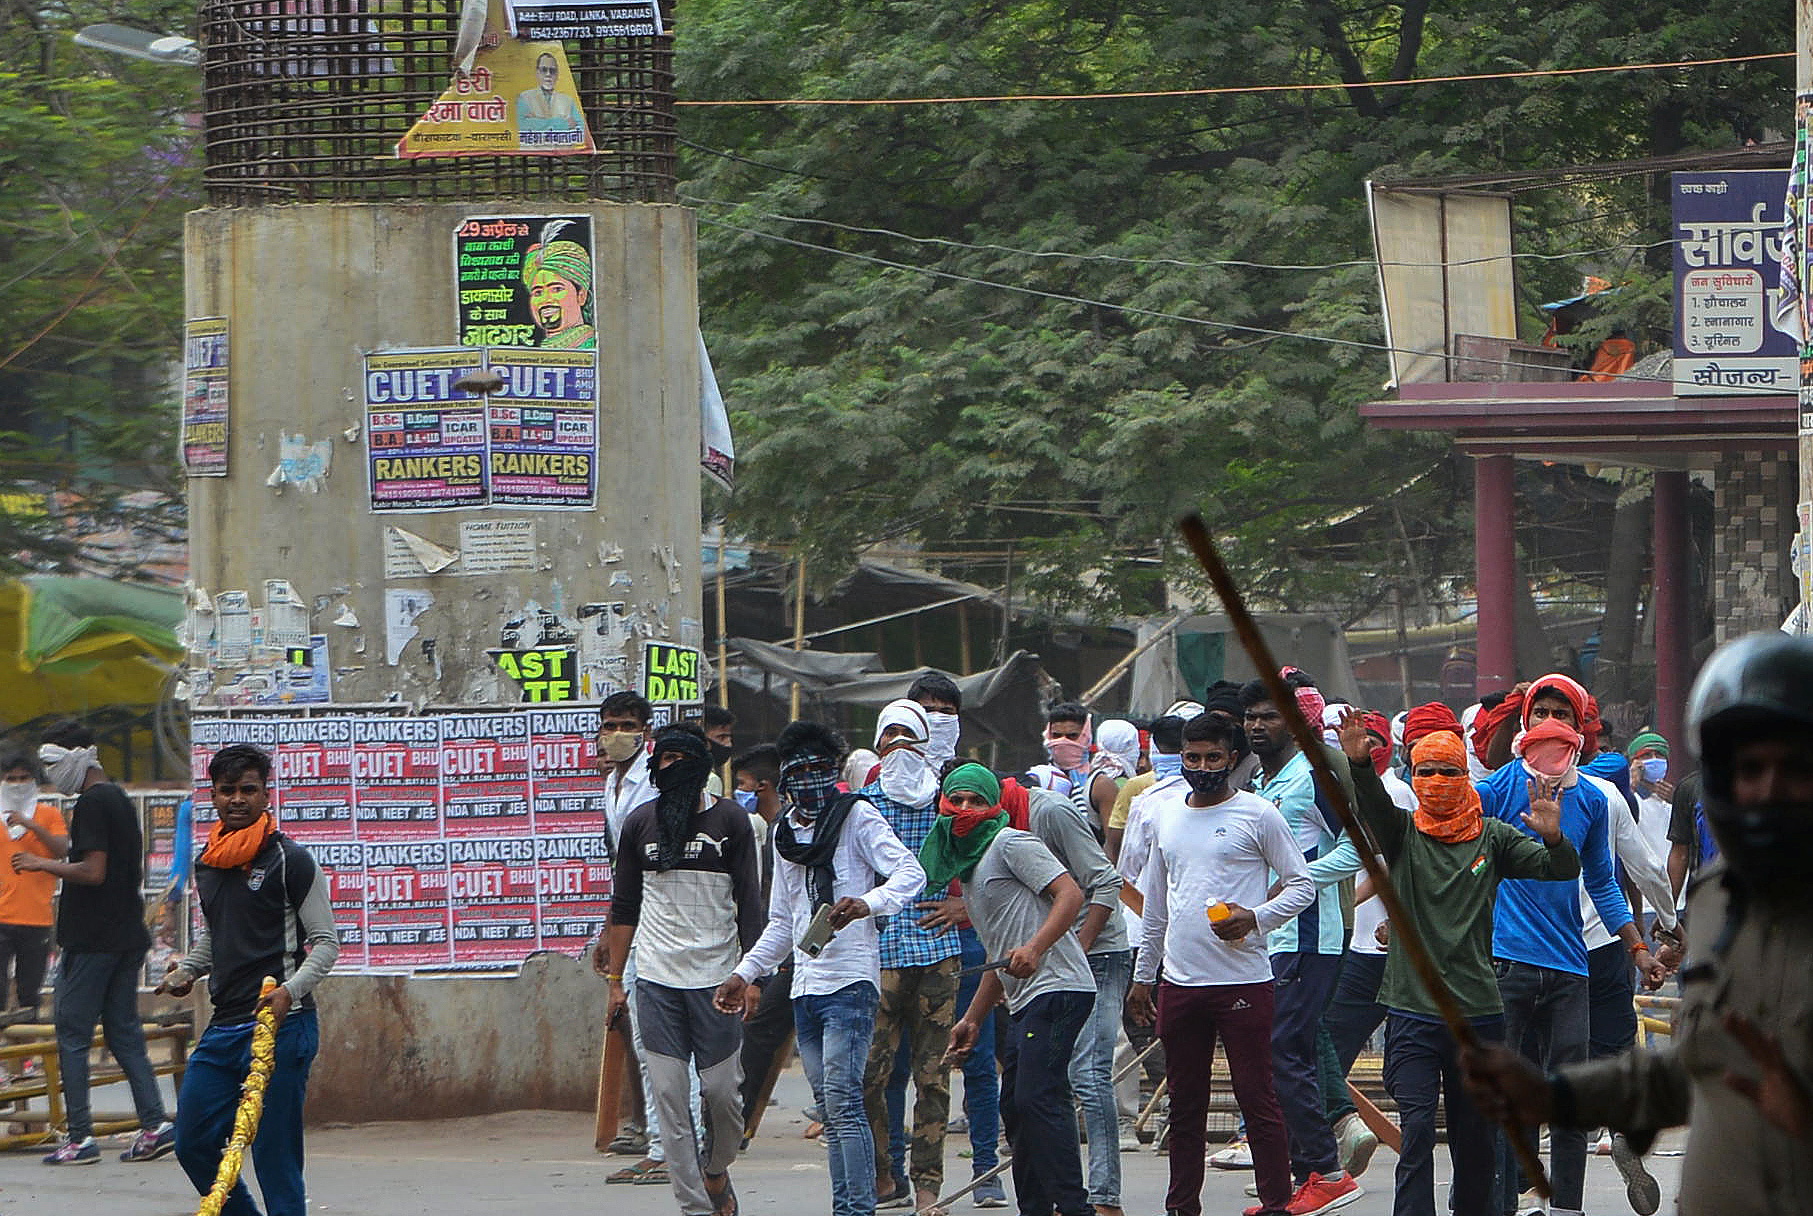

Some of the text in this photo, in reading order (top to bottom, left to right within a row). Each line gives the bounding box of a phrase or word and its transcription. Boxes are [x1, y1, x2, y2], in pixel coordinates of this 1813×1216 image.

[580, 10, 608, 22] LANKA,
[611, 9, 653, 19] VARANASI
[459, 220, 529, 238] 29 अप्रैल से
[1691, 277, 1708, 286] जन
[1692, 295, 1747, 308] 1. शौचालय
[1691, 316, 1754, 327] 2. स्नानागार
[1691, 333, 1741, 350] 3. यूरिनल
[368, 369, 453, 402] CUET
[490, 366, 569, 397] CUET
[446, 421, 478, 433] ICAR
[559, 422, 588, 433] ICAR
[375, 455, 481, 479] RANKERS
[492, 454, 589, 476] RANKERS
[499, 651, 568, 679] AST
[651, 647, 697, 679] LAST
[523, 681, 571, 702] TE
[649, 675, 697, 702] DATE
[279, 722, 349, 743] RANKERS
[355, 722, 437, 742] RANKERS
[443, 716, 526, 738] RANKERS
[444, 746, 528, 775] CUET BHU
[446, 802, 527, 817] NDA NEET JEE
